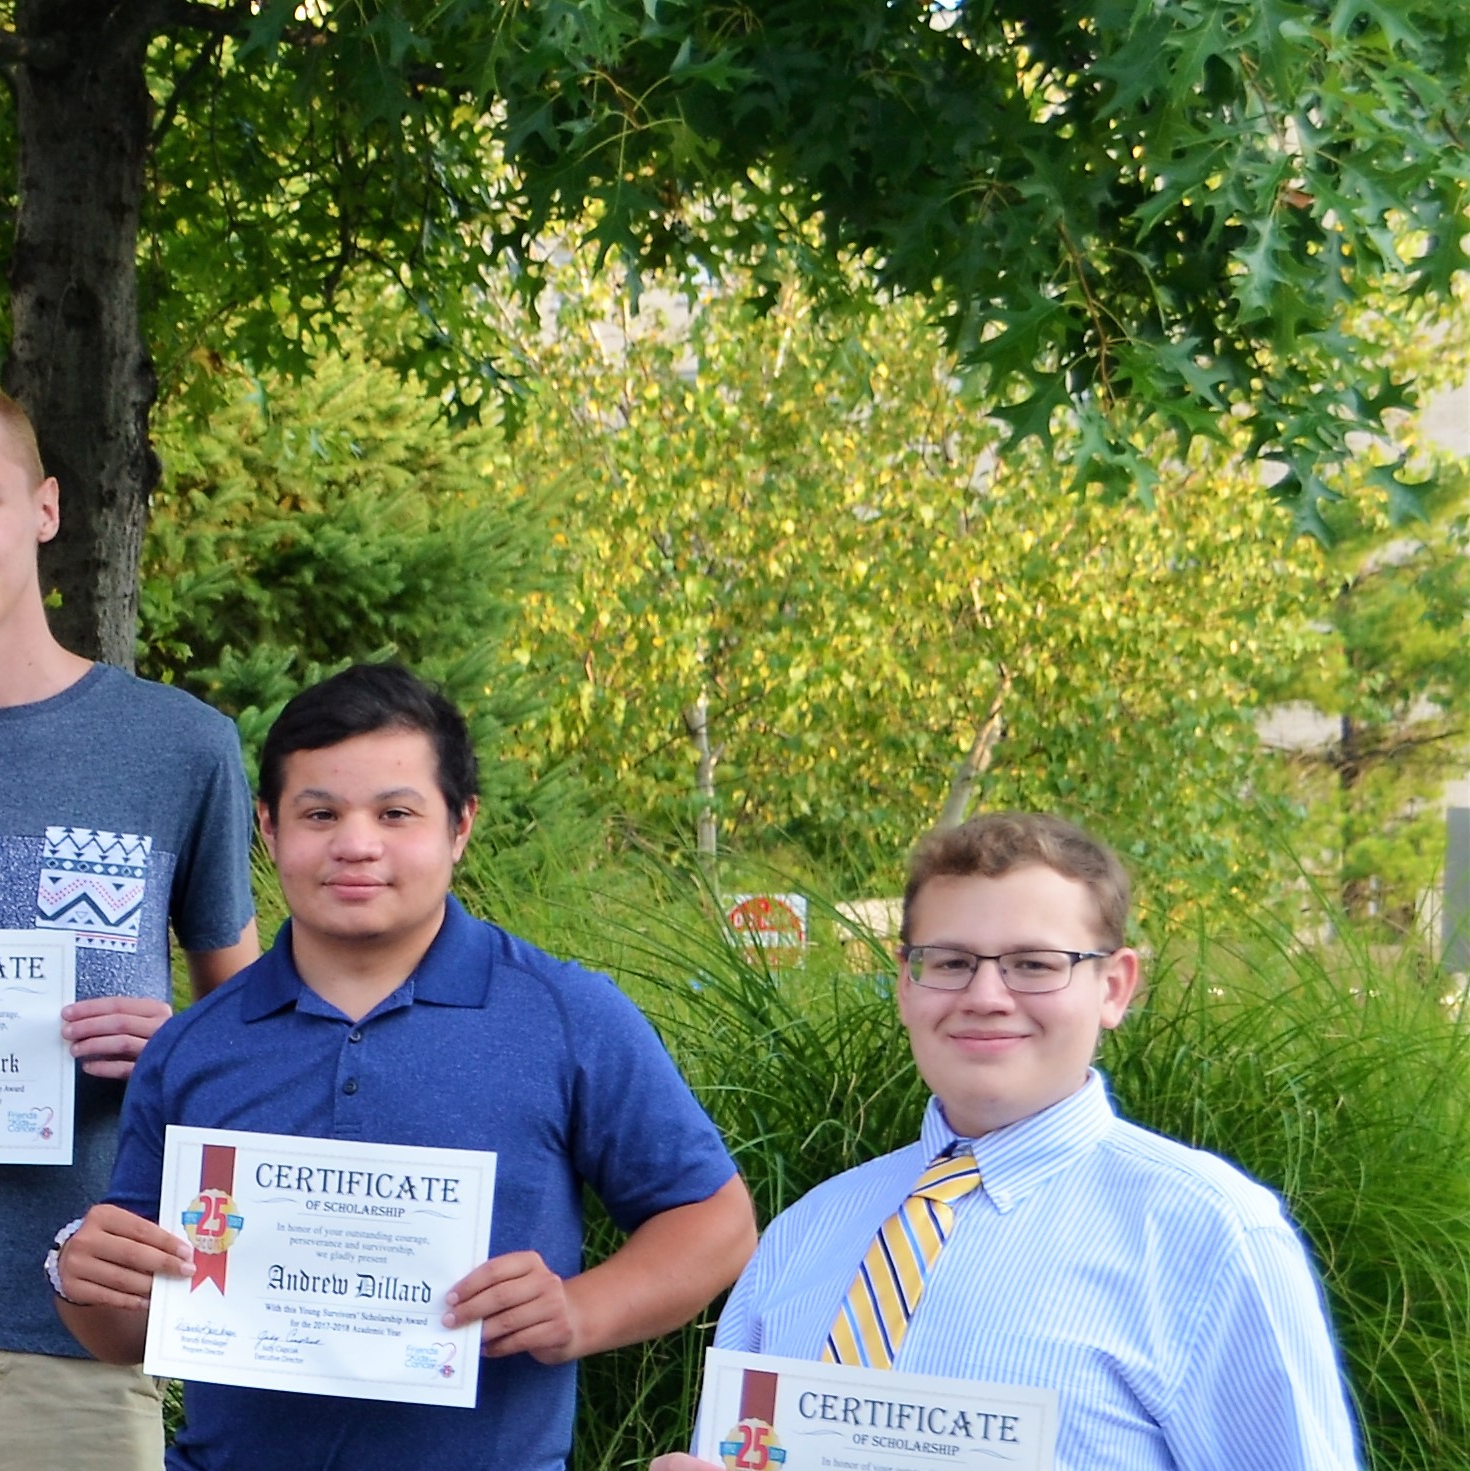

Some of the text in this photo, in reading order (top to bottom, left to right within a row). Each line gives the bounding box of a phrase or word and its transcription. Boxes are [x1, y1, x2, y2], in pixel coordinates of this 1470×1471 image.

[255, 1162, 460, 1204] CERTIFICATE
[196, 1196, 228, 1236] 25
[306, 1200, 405, 1218] OF SCHOLARSHIP
[276, 1222, 285, 1231] In
[287, 1223, 310, 1233] honor
[313, 1225, 323, 1234] of
[324, 1228, 343, 1238] your
[345, 1228, 392, 1242] outstanding
[289, 1236, 343, 1249] perseverance
[344, 1239, 359, 1249] and
[315, 1250, 387, 1265] we gladly present
[267, 1265, 432, 1304] Andrew Dillard
[289, 1319, 400, 1337] for the 2017-2018 Academic Year
[798, 1391, 1019, 1444] CERTIFICATE
[735, 1426, 768, 1470] 25
[853, 1433, 960, 1457] OF SCHOLARSHIP
